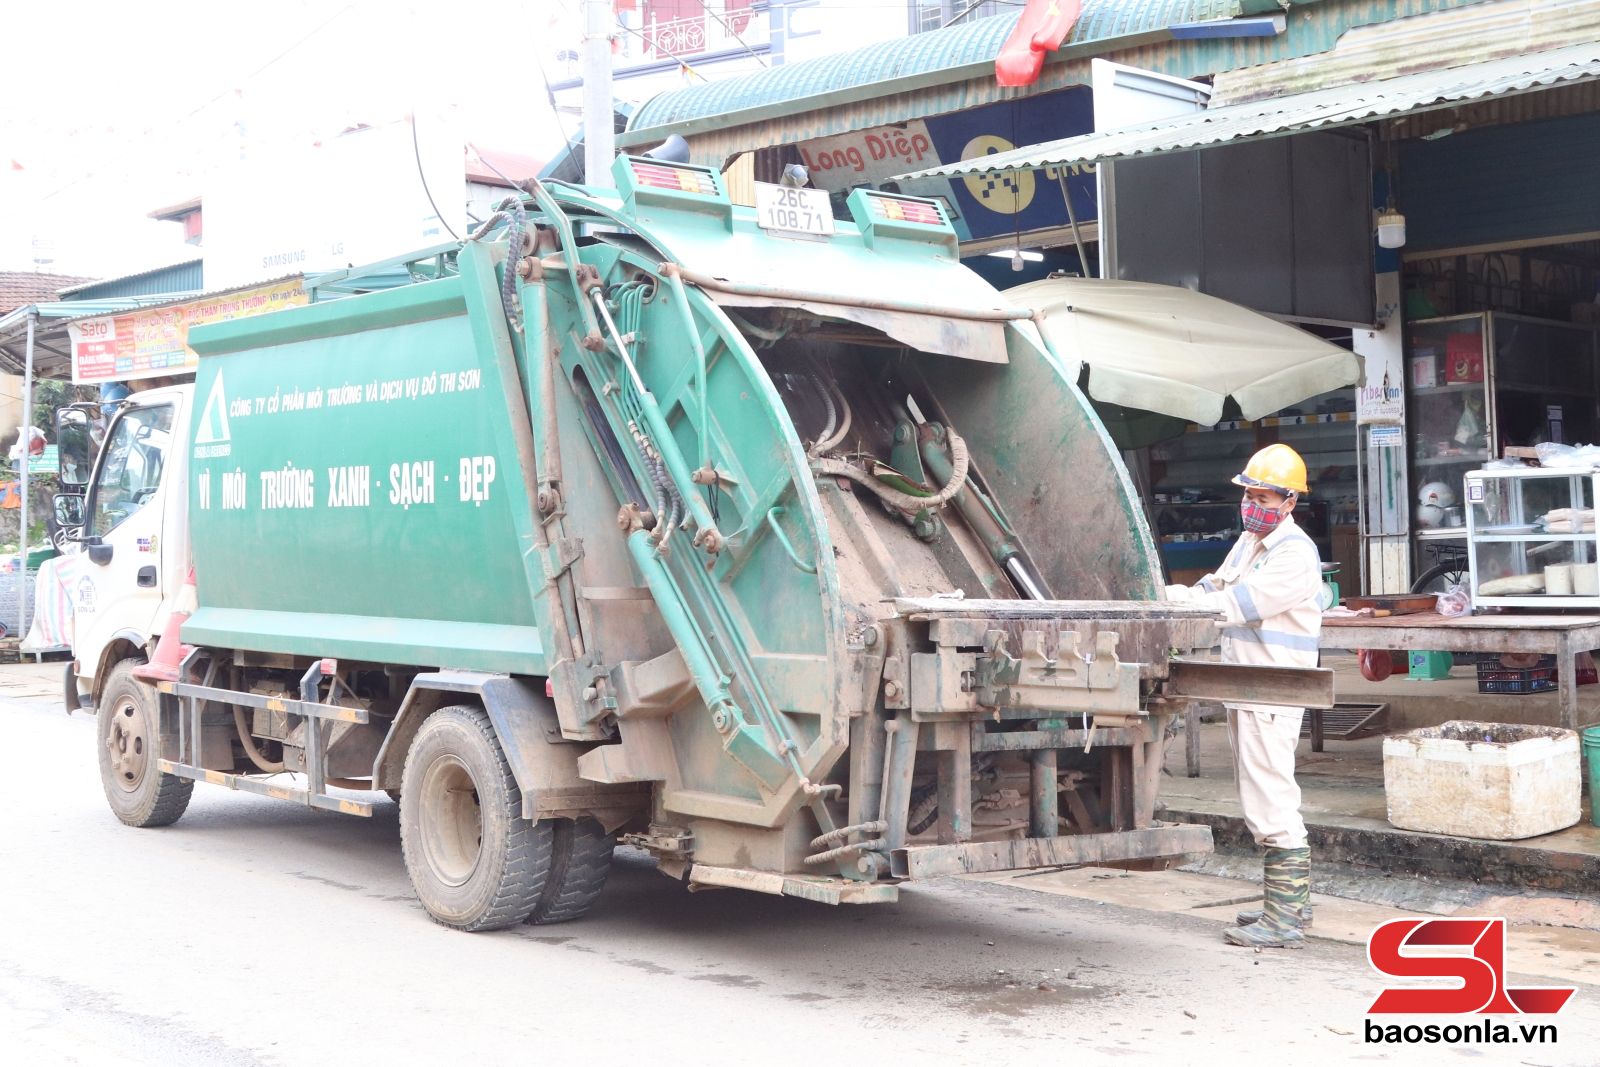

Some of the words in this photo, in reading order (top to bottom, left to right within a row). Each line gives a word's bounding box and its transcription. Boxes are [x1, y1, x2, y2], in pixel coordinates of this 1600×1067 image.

[801, 146, 865, 172] Long
[864, 130, 929, 164] Diệp
[768, 208, 824, 231] 108.71
[262, 249, 306, 269] SAMSUNG
[331, 242, 344, 256] LG
[81, 321, 108, 337] Sato
[230, 396, 252, 418] CÔNG
[255, 397, 266, 415] TY
[306, 386, 324, 409] MÔI
[327, 380, 362, 407] TRƯỜNG
[365, 379, 378, 402] VÀ
[379, 379, 403, 404] DỊCH
[405, 377, 420, 401] VỤ
[199, 467, 210, 510] VÌ
[222, 467, 246, 510] MÔI
[260, 460, 314, 510] TRƯỜNG
[328, 465, 370, 507] XANH
[389, 460, 435, 510] SẠCH
[459, 455, 496, 507] ĐẸP
